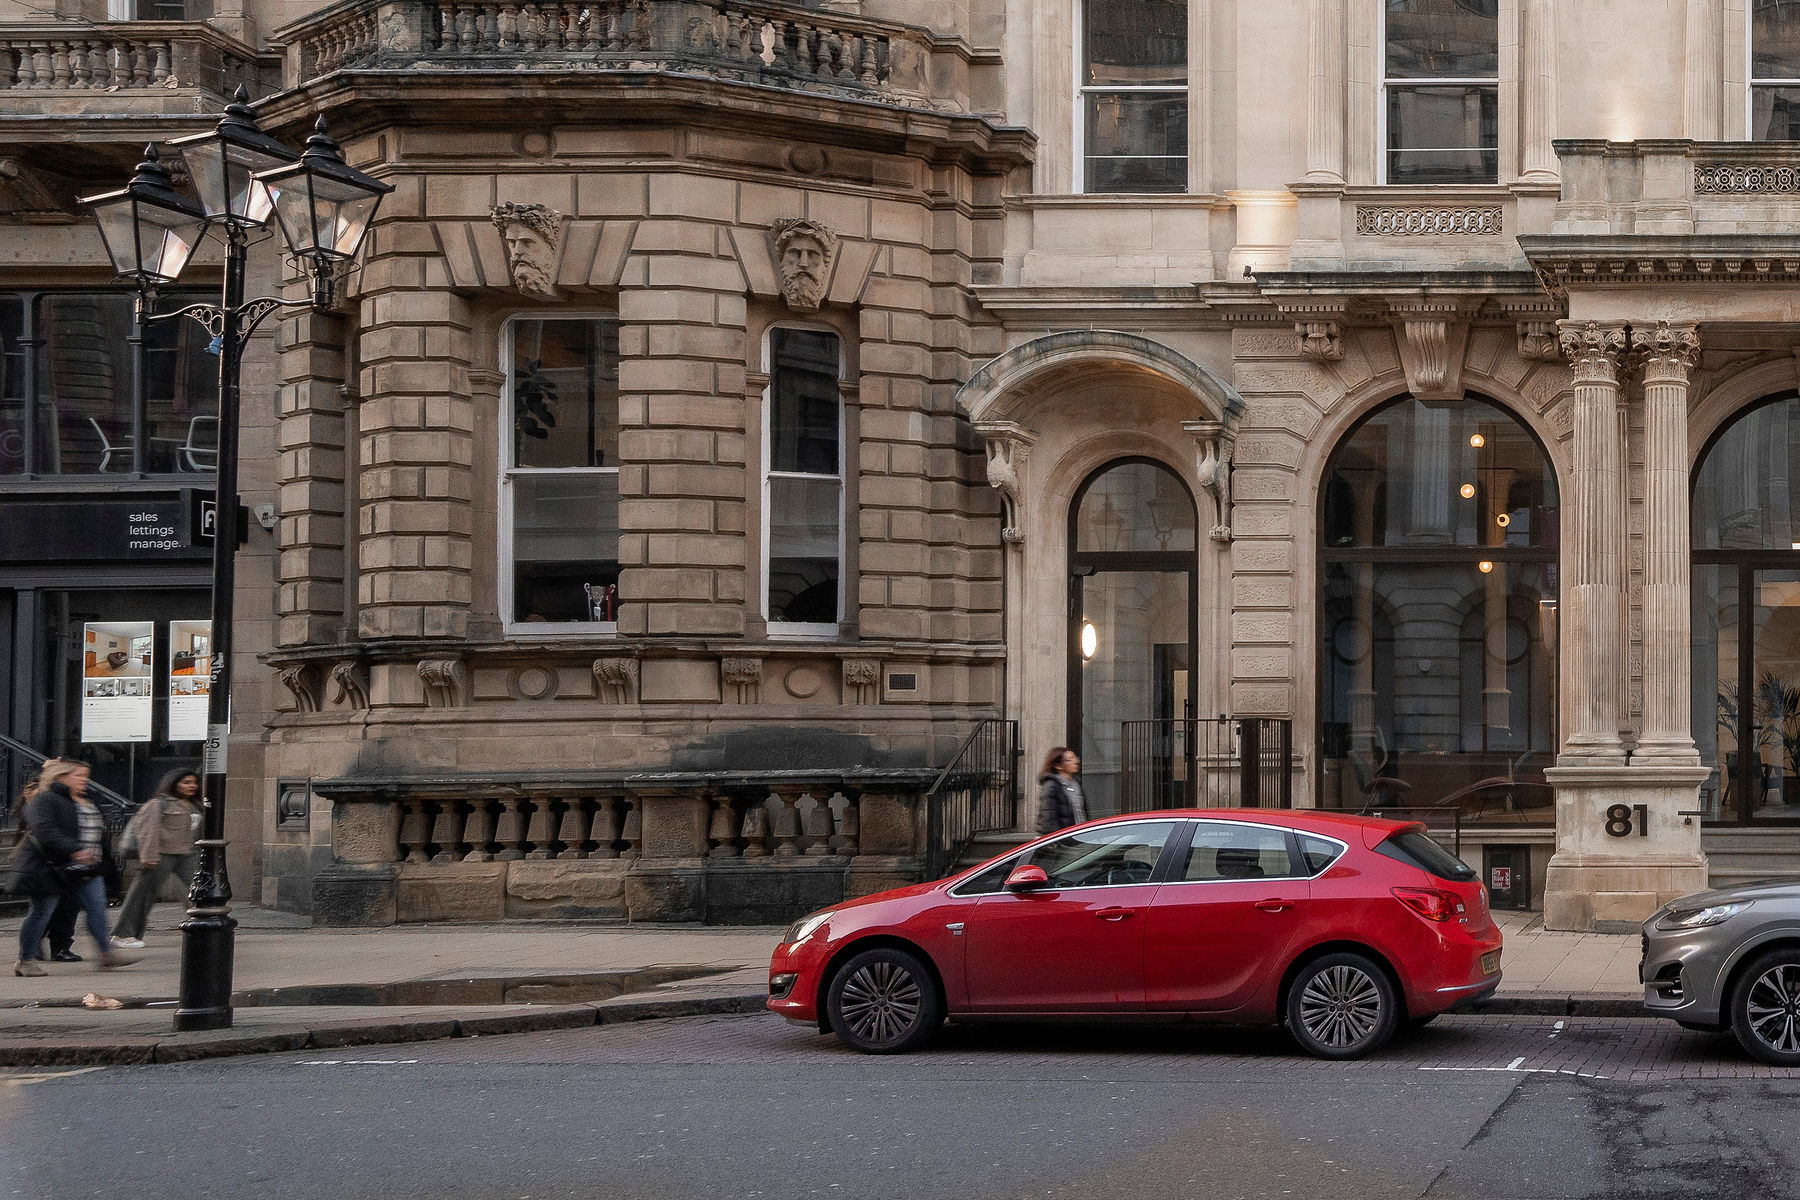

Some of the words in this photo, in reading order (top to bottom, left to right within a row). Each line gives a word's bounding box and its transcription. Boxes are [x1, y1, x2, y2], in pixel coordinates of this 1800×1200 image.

[129, 512, 158, 522] sales
[129, 525, 174, 537] lettings
[1604, 803, 1648, 837] 81
